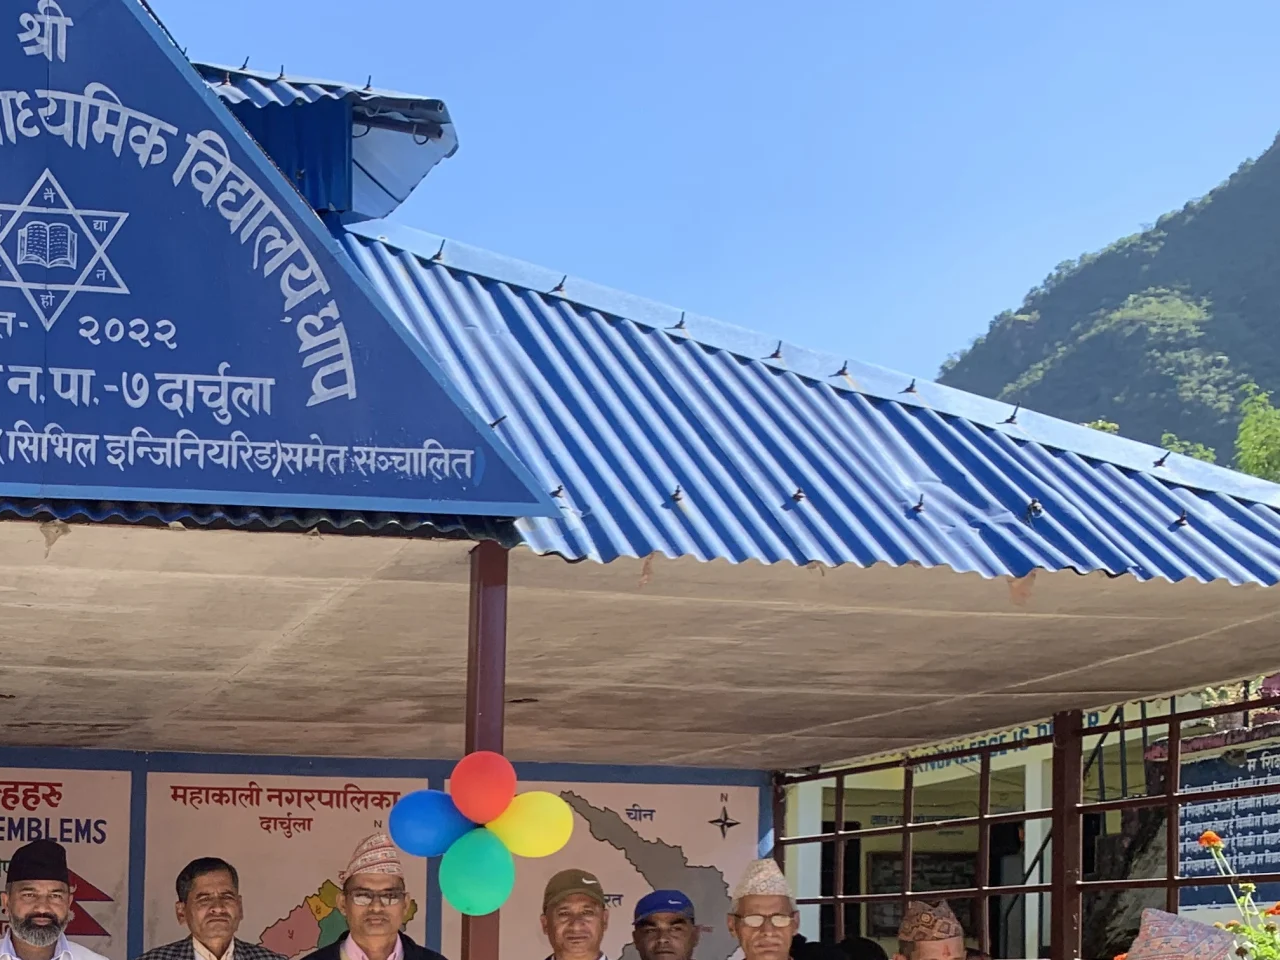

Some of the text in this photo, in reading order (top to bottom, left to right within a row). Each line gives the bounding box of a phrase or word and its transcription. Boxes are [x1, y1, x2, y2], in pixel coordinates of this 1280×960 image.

[17, 0, 73, 62] श्री
[79, 315, 177, 349] २०२२
[154, 361, 276, 425] दार्चुला
[170, 781, 400, 812] महाकाली नगरपालिका
[720, 793, 728, 802] N
[259, 812, 313, 838] दार्चुला
[373, 819, 382, 828] N
[626, 803, 656, 822] चीन
